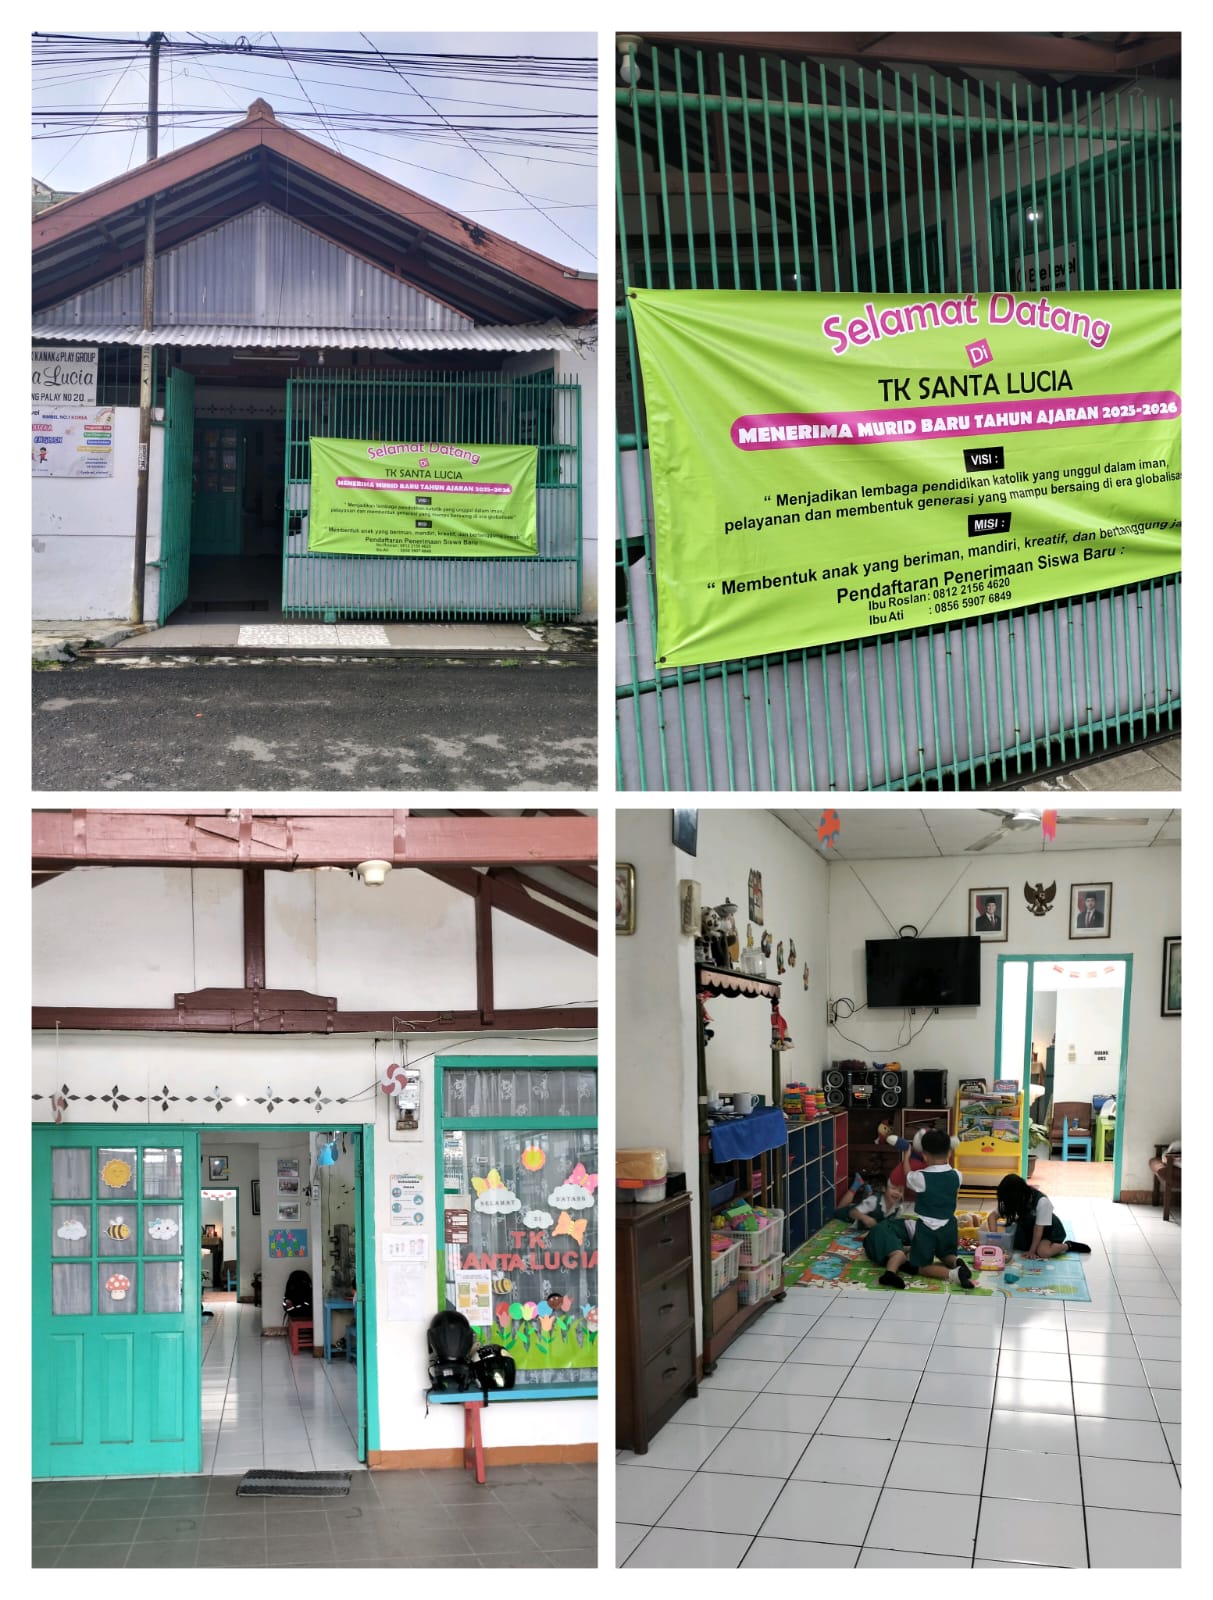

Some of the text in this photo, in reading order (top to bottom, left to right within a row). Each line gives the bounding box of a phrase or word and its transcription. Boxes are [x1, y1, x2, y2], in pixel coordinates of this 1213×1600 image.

[823, 293, 1111, 354] Selamat Datang
[61, 352, 74, 362] PLAY
[75, 352, 96, 363] GROUP
[970, 345, 989, 364] Di
[43, 365, 93, 387] Lucia
[878, 369, 1073, 402] TK SANTA LUCIA
[41, 393, 60, 402] PALAY
[73, 394, 85, 402] 20
[738, 402, 1178, 444] MENERIMA MURID BARU TAHUN AJARAN 2025-2026
[367, 442, 481, 465] Selamat Datang
[971, 453, 992, 466] VISI
[385, 468, 463, 480] TK SANTA LUCIA
[776, 487, 858, 507] Menjadikan
[861, 482, 918, 498] lembaga
[922, 475, 990, 495] pendidikan
[993, 471, 1029, 485] katolik
[1032, 469, 1060, 484] yang
[1063, 464, 1101, 481] unggul
[1104, 462, 1136, 473] dalam
[1139, 458, 1169, 470] iman,
[724, 512, 801, 535] pelayanan
[805, 509, 832, 522] dan
[836, 498, 914, 519] membentuk
[917, 494, 974, 511] generasi
[978, 491, 1007, 506] yang
[1010, 487, 1048, 500] mampu
[1051, 480, 1100, 495] bersaing
[1103, 478, 1113, 489] di
[1116, 478, 1134, 488] era
[974, 518, 998, 532] MISI
[721, 569, 817, 595] Membentuk
[822, 563, 858, 580] anak
[863, 558, 899, 577] yang
[903, 549, 964, 568] beriman,
[968, 538, 1021, 558] mandiri,
[1024, 532, 1068, 548] kreatif,
[1072, 531, 1096, 542] dan
[1100, 519, 1168, 539] bertanggung
[837, 574, 940, 603] Pendaftaran
[943, 560, 1033, 586] Penerimaan
[1037, 551, 1079, 570] Siswa
[1083, 546, 1116, 561] Baru
[868, 598, 886, 611] Ibu
[933, 586, 958, 600] 0812
[960, 581, 984, 595] 2156
[986, 577, 1010, 590] 4620
[869, 614, 887, 626] Ibu
[888, 609, 904, 622] Ati
[934, 601, 959, 615] 0856
[962, 597, 986, 610] 5907
[988, 590, 1012, 604] 6849
[511, 1231, 546, 1249] TK
